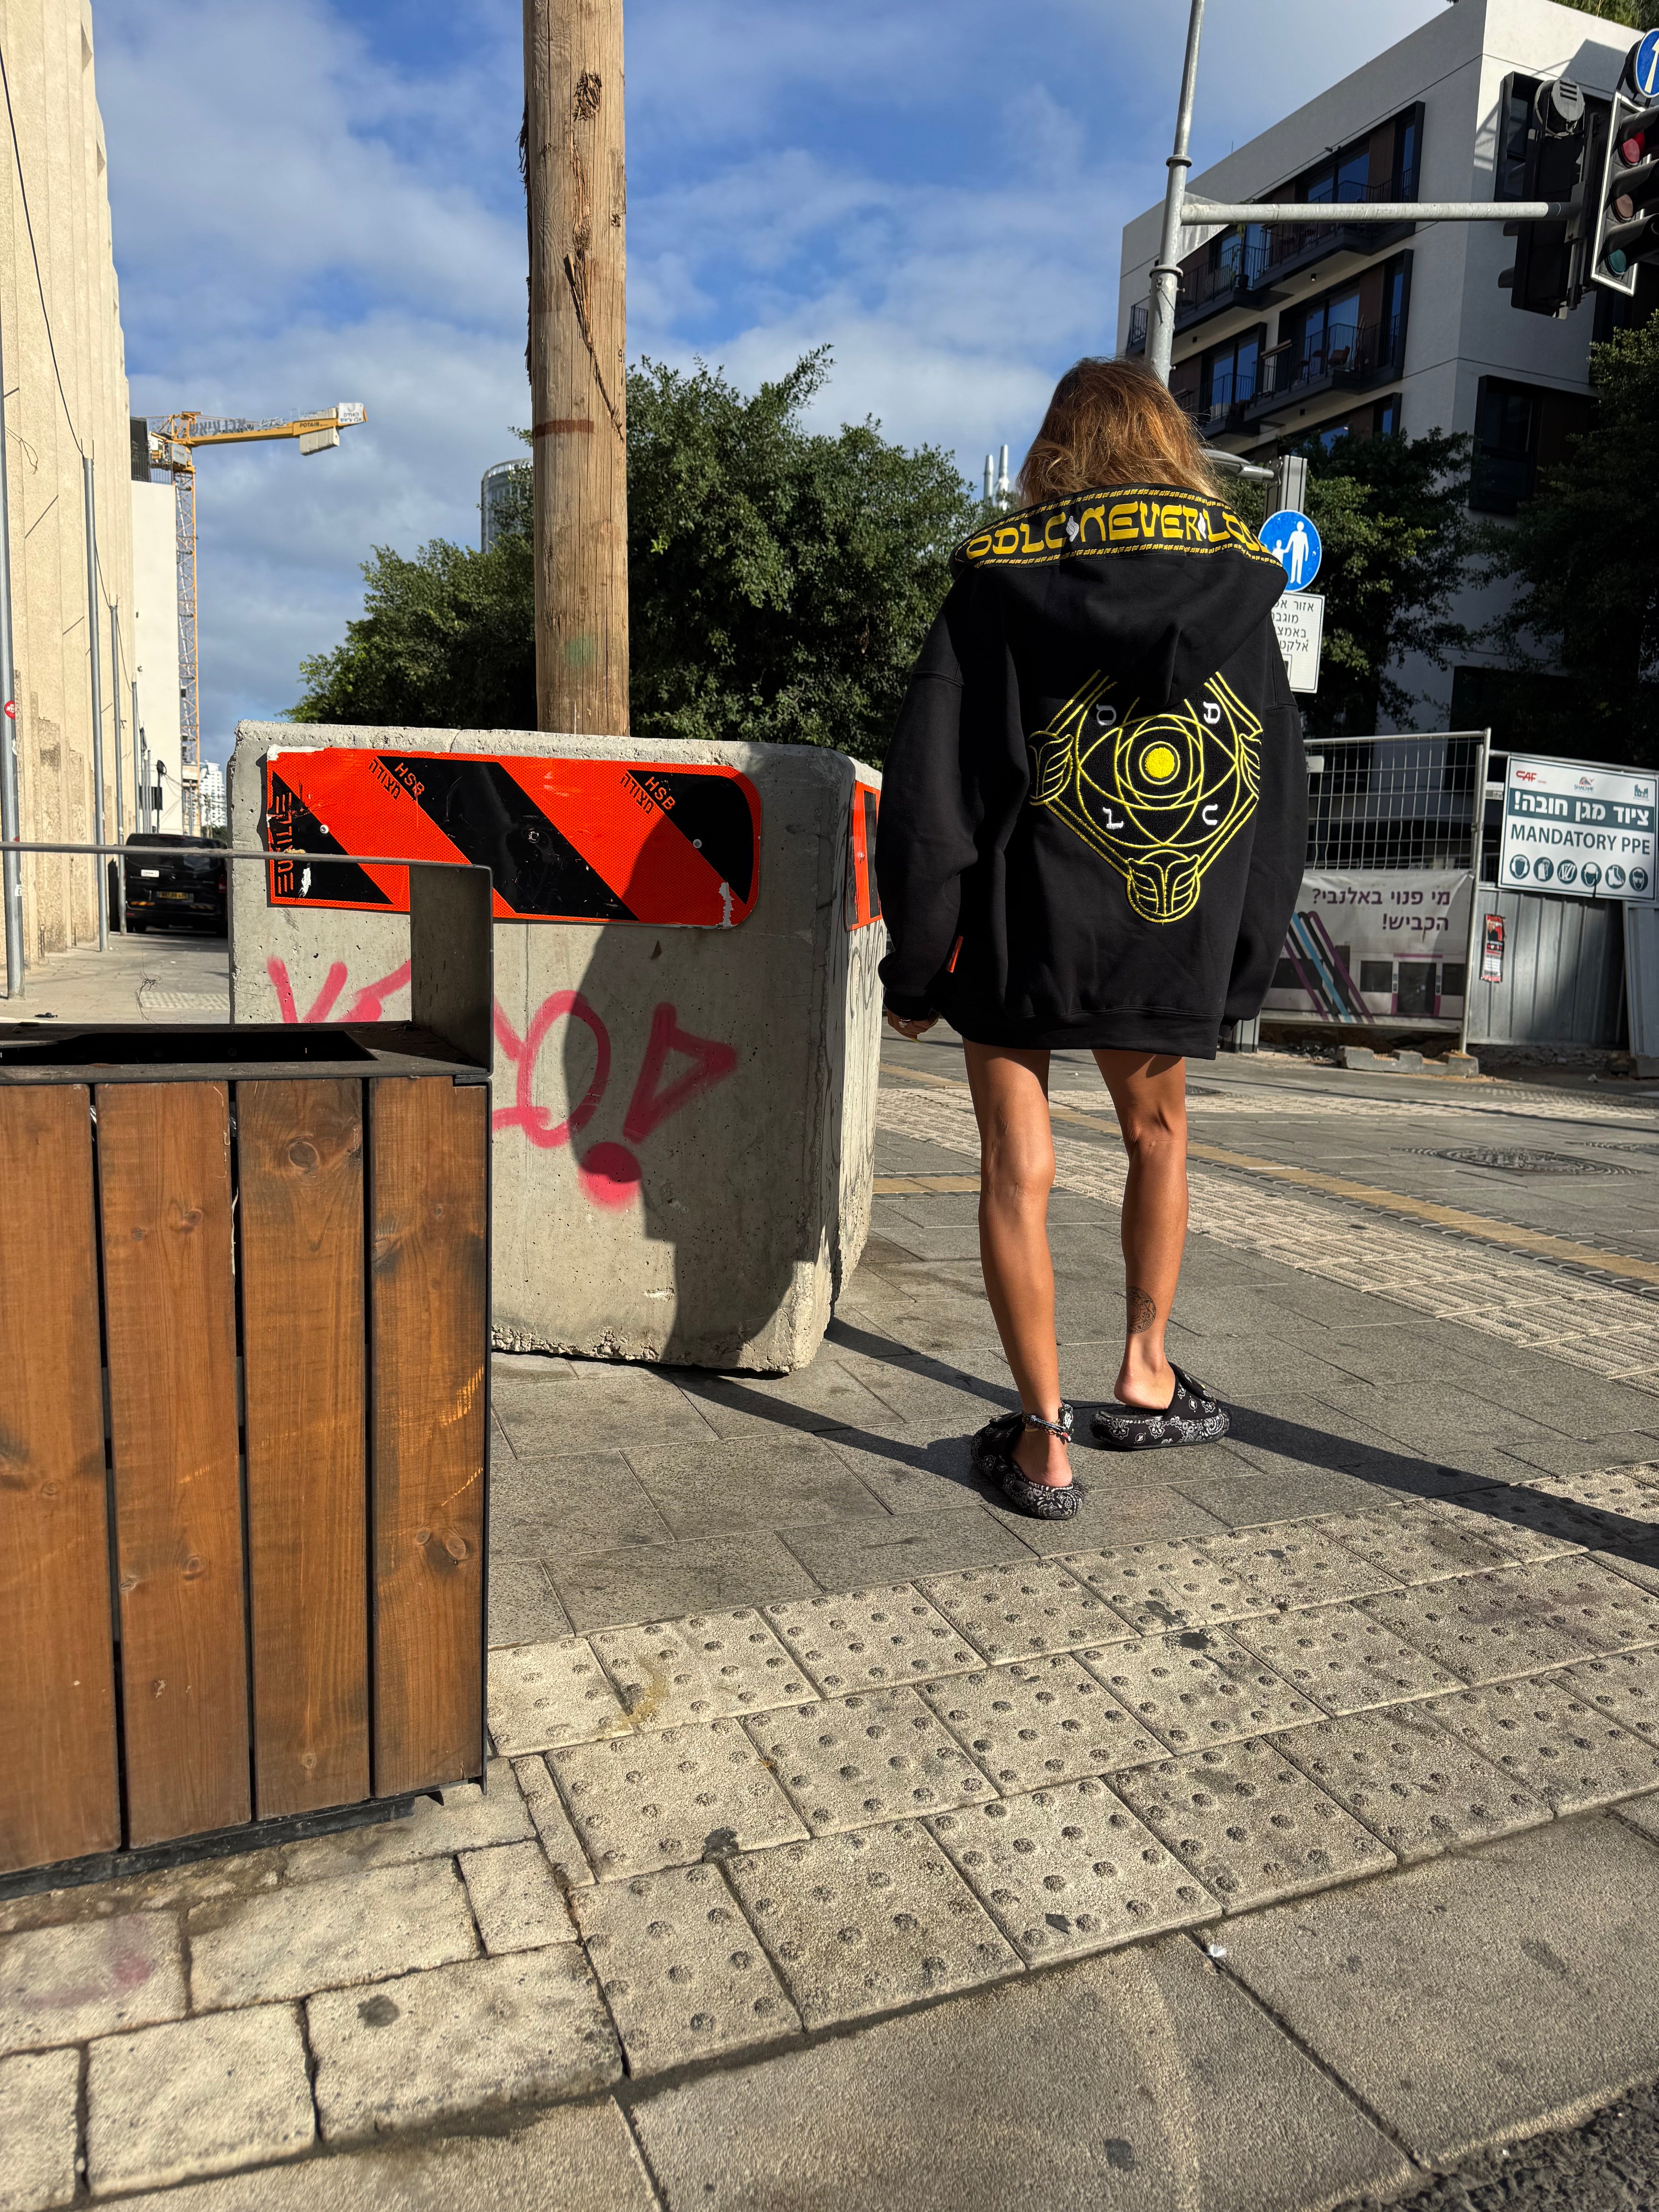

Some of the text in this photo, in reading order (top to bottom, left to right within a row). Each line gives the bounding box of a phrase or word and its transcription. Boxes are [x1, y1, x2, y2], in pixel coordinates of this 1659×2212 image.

[1080, 500, 1202, 543] NEVER
[1294, 601, 1314, 612] אזור
[394, 763, 425, 795] HSB
[1516, 770, 1537, 782] CAF
[645, 776, 675, 810] HSB
[1514, 791, 1649, 826] ציוד מגן חובה!
[1511, 823, 1650, 855] MANDATORY PPE
[1312, 887, 1450, 905] מי פנוי באלנבי?
[1382, 914, 1449, 931] הכביש!
